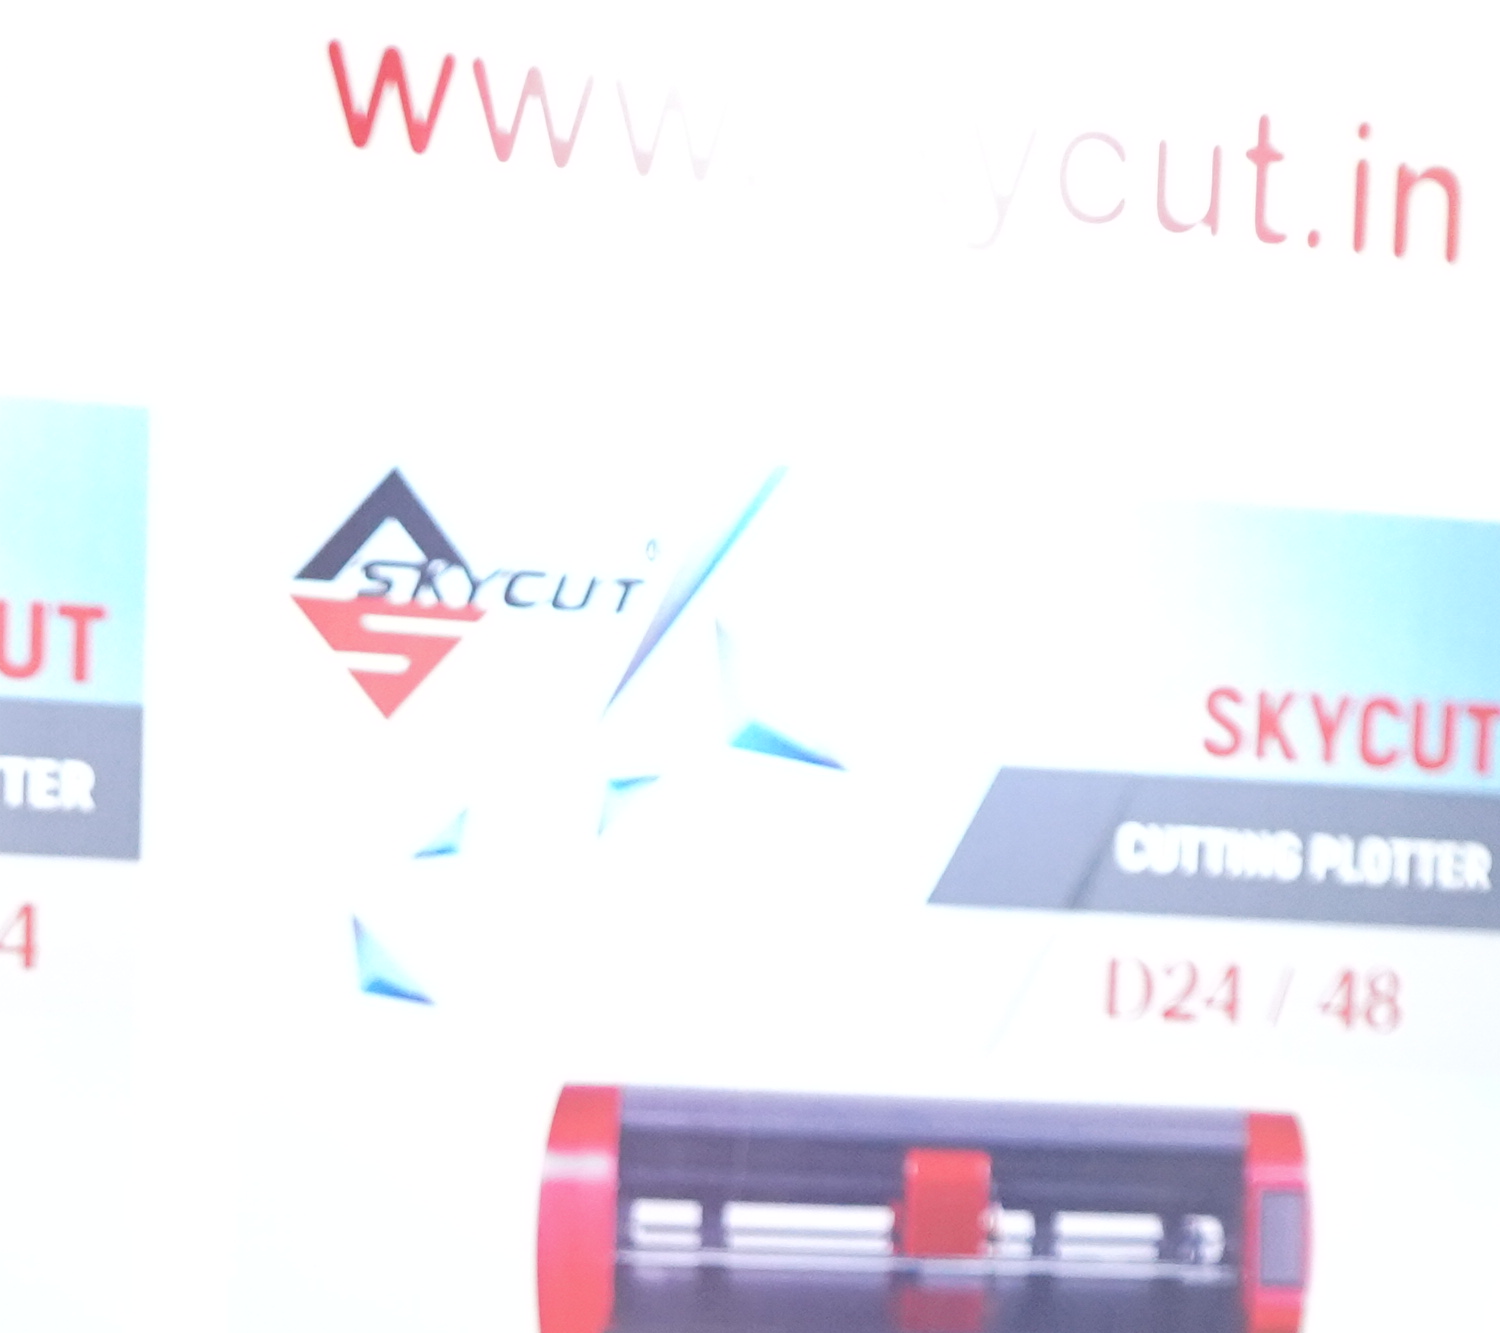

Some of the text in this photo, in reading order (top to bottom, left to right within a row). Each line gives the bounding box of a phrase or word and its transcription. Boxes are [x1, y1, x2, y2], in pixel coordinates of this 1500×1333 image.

[322, 36, 1468, 266] www.ycut.in
[357, 559, 645, 614] SKYCUT
[1114, 820, 1493, 893] CUTTING PLOTTER
[1104, 955, 1242, 1027] D24
[1317, 963, 1404, 1036] 48
